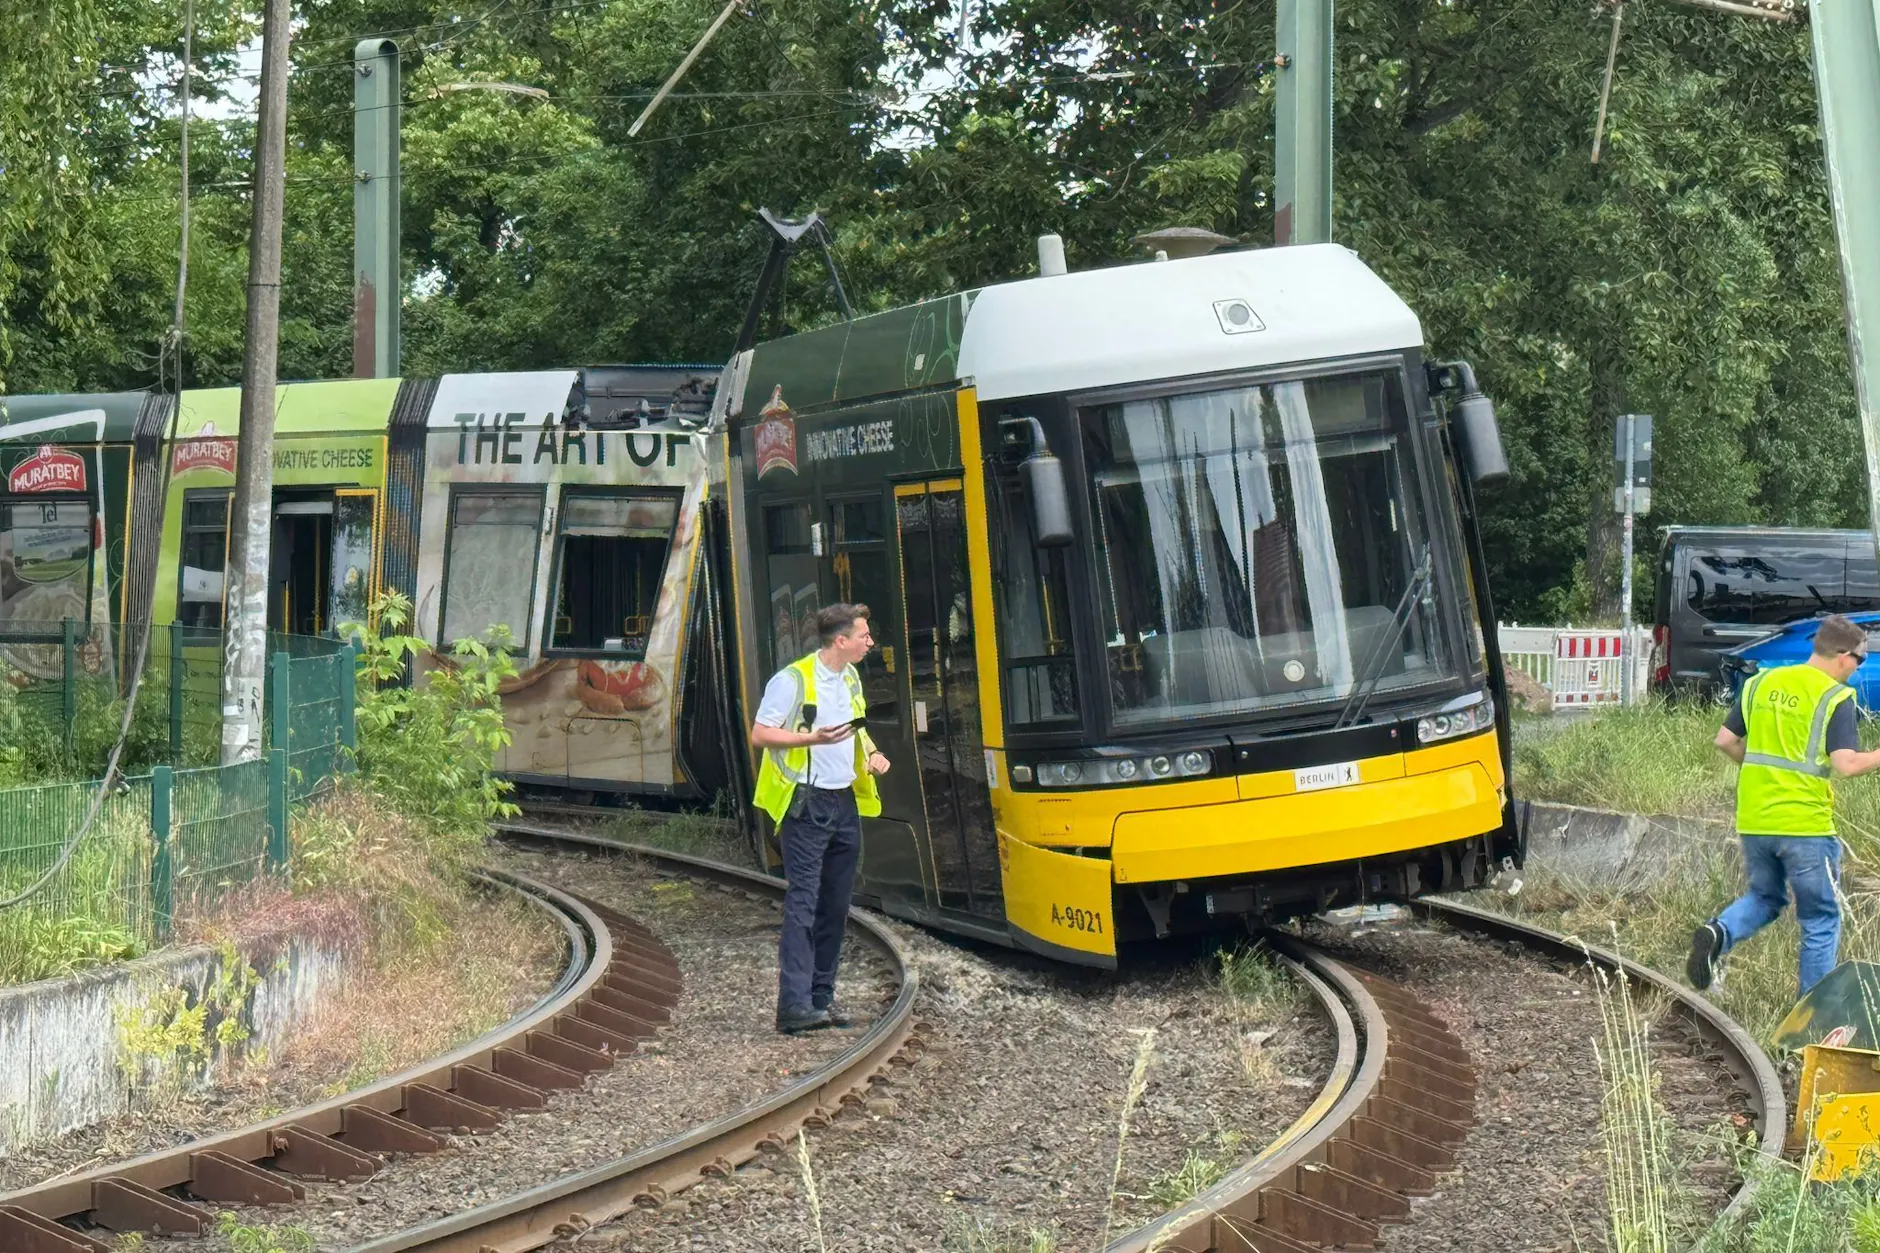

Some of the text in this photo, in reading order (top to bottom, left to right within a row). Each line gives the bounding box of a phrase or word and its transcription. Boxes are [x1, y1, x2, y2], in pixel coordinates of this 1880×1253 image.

[453, 412, 526, 465] THE
[856, 420, 895, 456] CHEESE
[177, 441, 233, 466] MURATBEY
[321, 447, 374, 469] CHEESE
[14, 463, 80, 493] MURATBEY
[1768, 689, 1800, 708] BVG
[1300, 772, 1335, 786] BERLIN
[1051, 903, 1103, 934] A-9021
